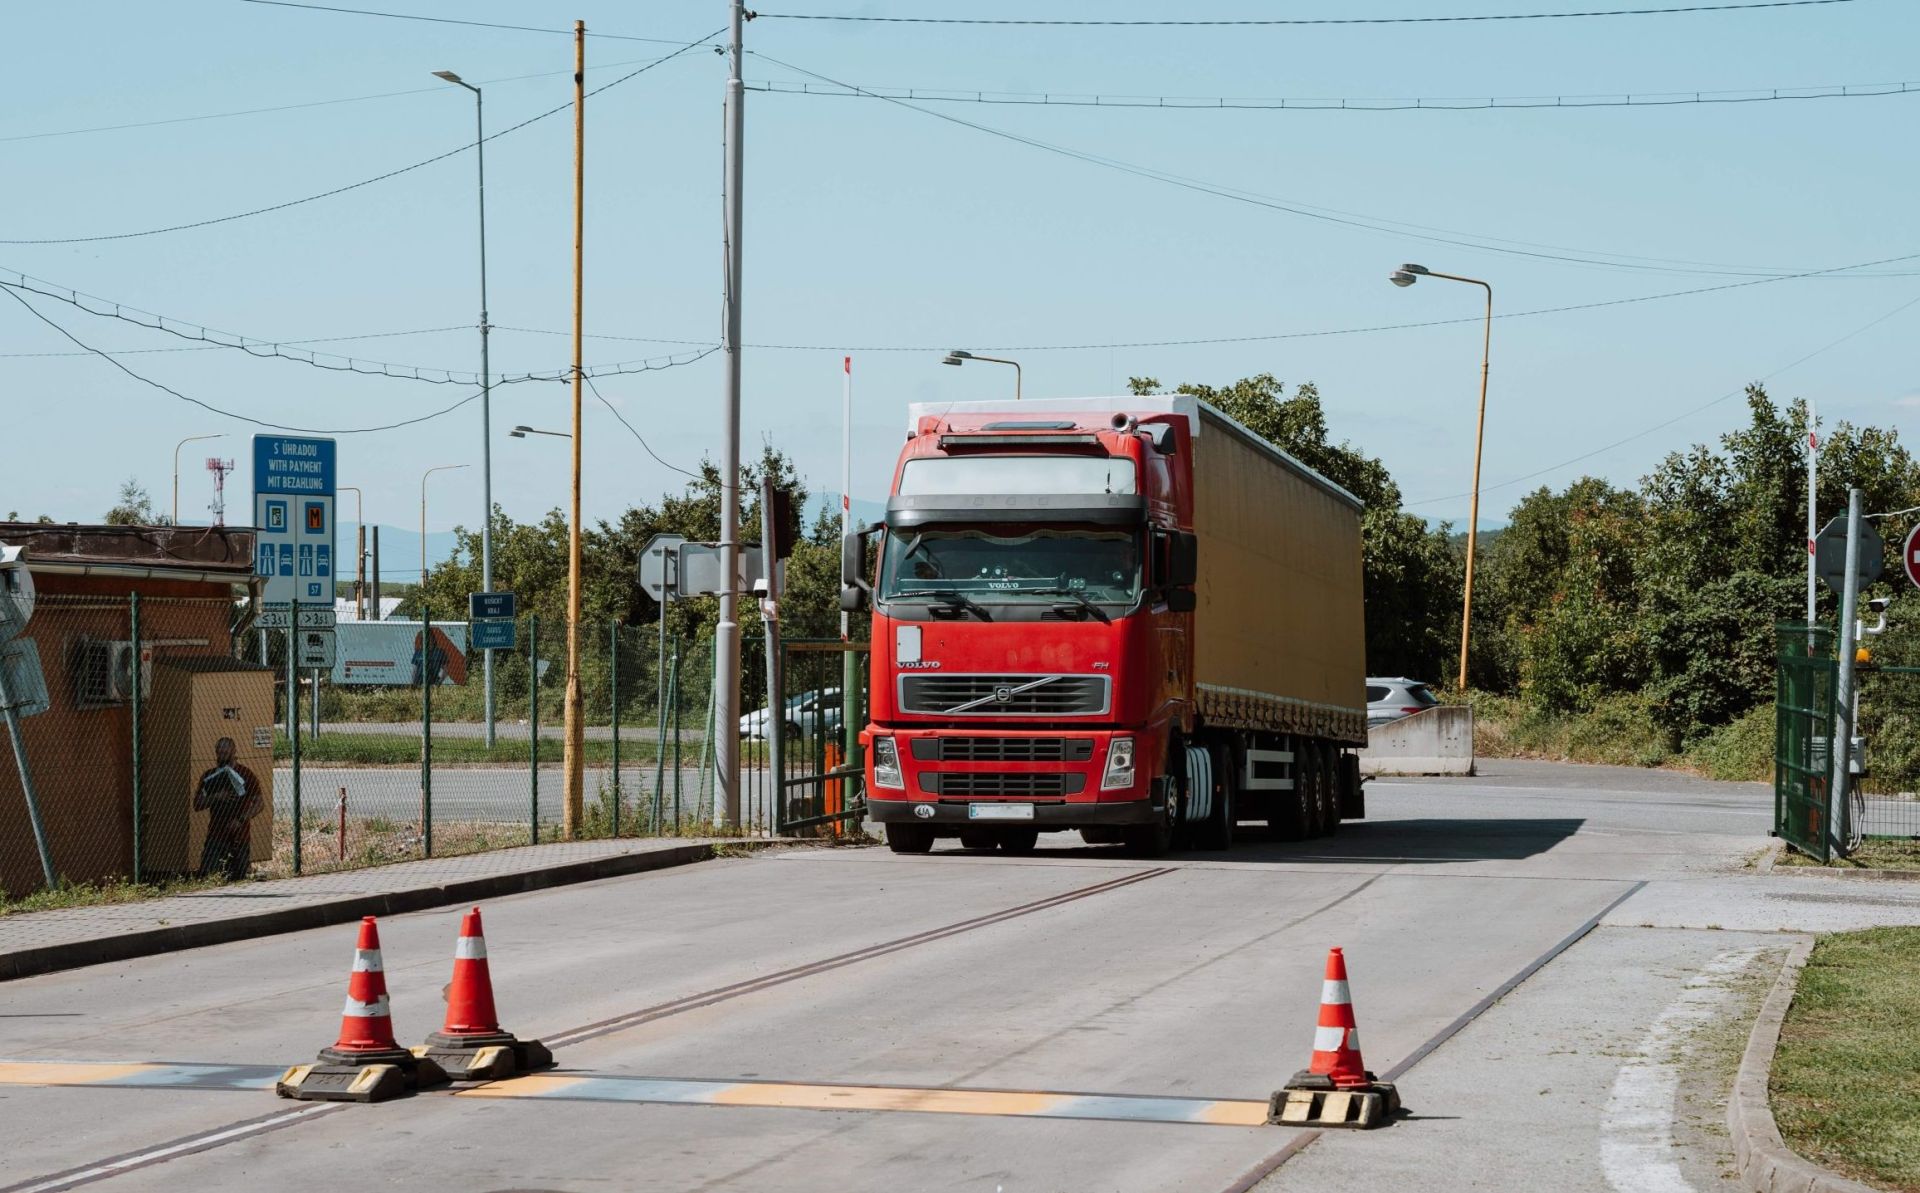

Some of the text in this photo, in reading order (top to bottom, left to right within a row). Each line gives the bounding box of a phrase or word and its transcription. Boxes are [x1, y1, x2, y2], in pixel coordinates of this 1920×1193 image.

[273, 440, 317, 457] S ÚHRADOU
[268, 459, 322, 473] WITH PAYMENT
[267, 475, 323, 490] MIT BEZAHLUNG
[896, 661, 942, 670] VOLVO
[1092, 661, 1110, 670] FH
